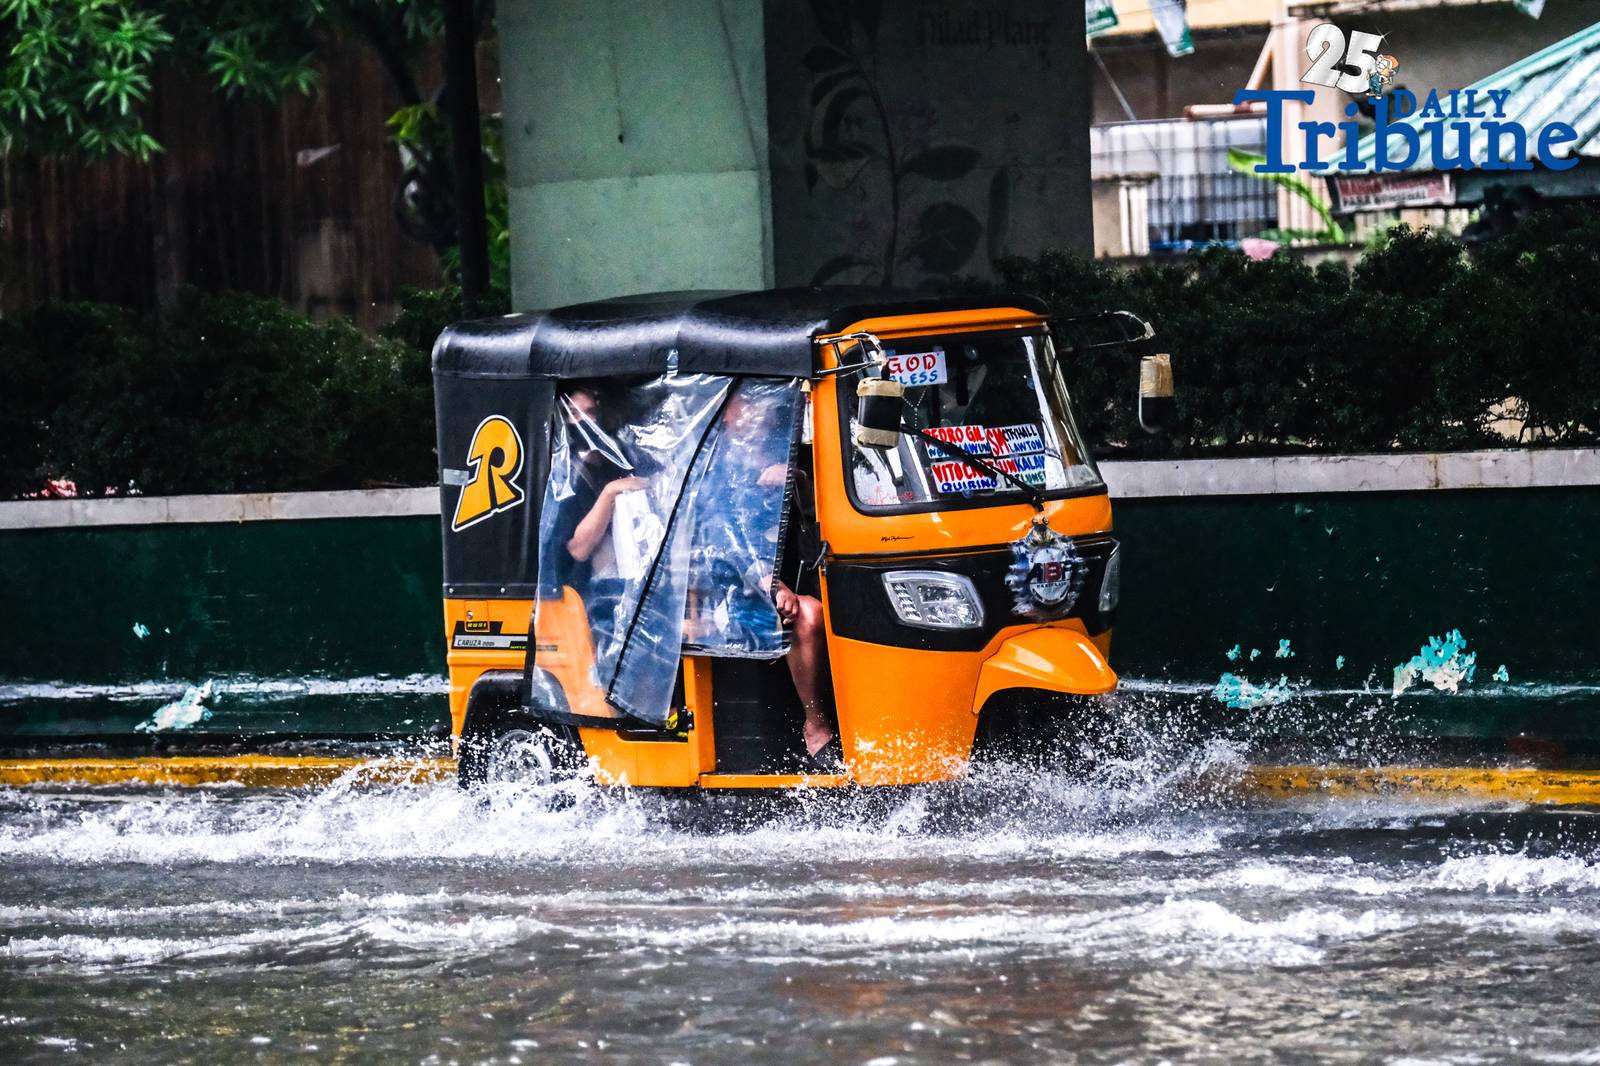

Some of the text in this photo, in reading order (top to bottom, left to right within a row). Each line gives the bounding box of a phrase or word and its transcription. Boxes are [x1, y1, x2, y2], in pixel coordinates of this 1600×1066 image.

[886, 354, 937, 374] GOD
[965, 426, 985, 442] GIL
[1009, 439, 1042, 453] LAWTON
